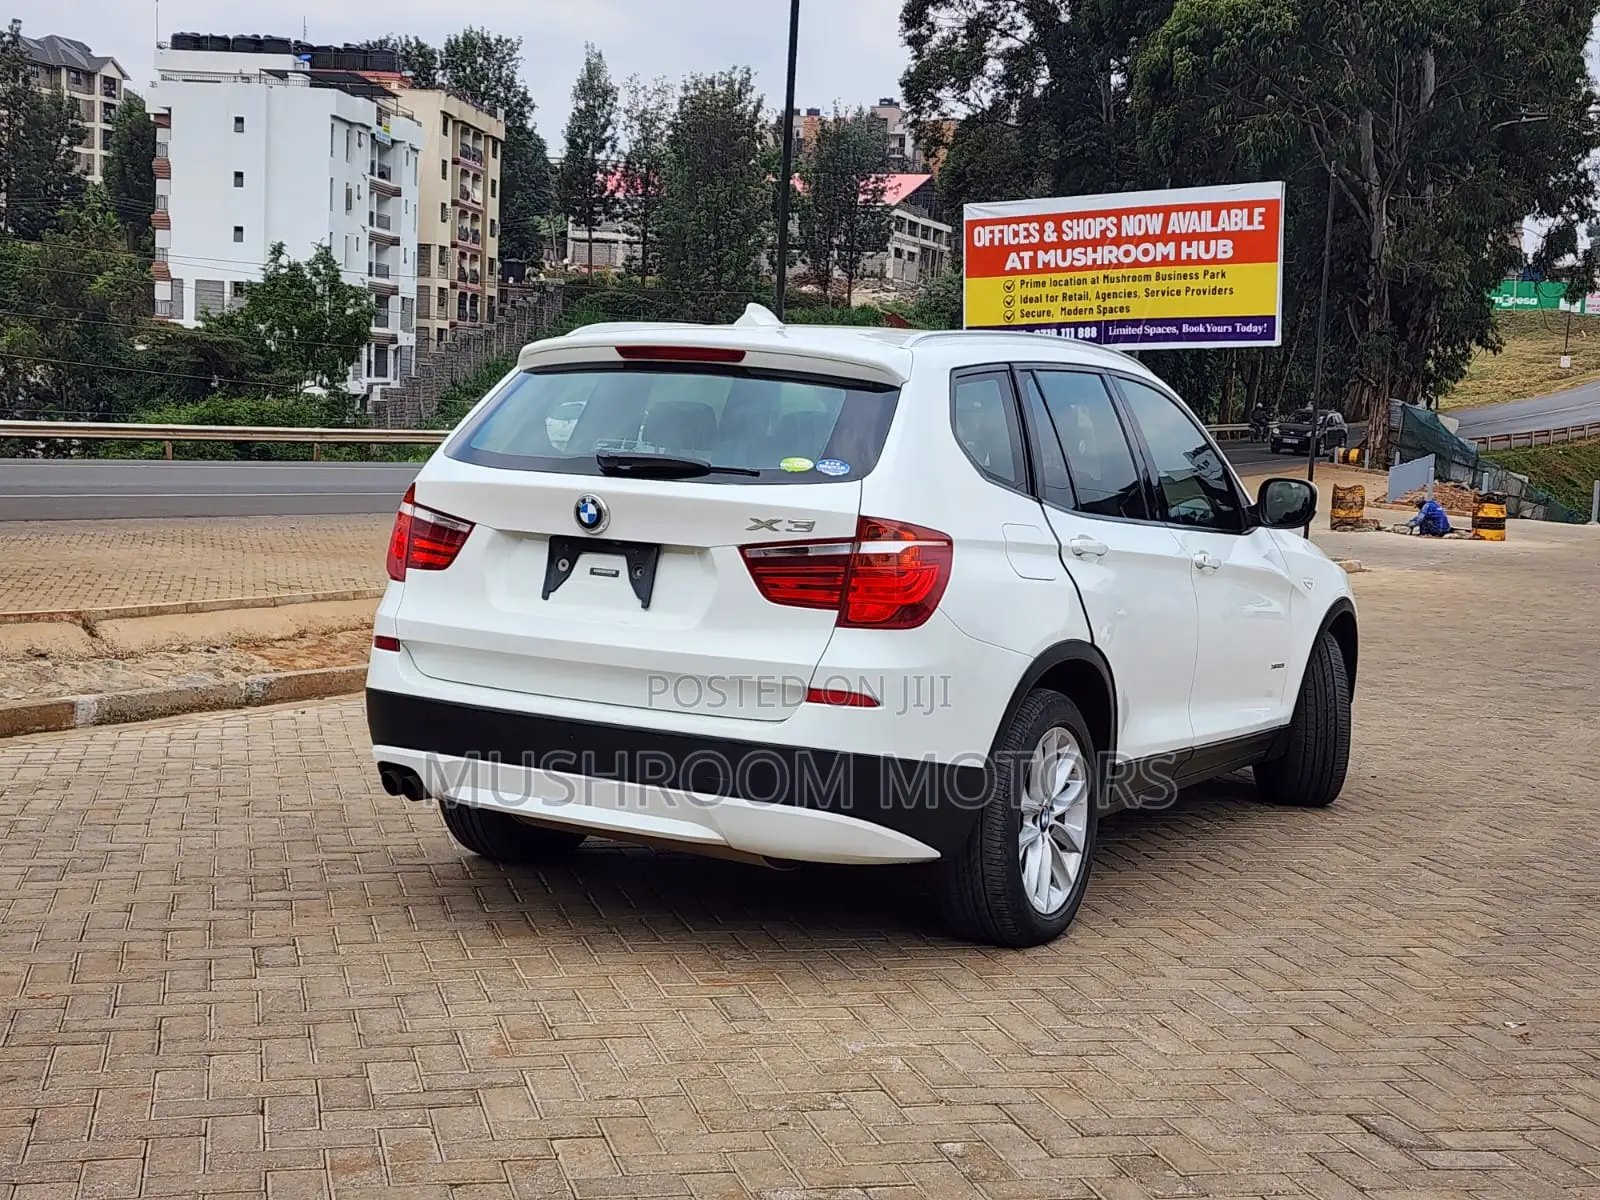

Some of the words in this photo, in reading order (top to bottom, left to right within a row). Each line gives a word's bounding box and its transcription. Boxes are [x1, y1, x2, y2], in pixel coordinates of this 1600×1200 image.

[974, 222, 1040, 247] OFFICES
[1043, 220, 1058, 243] &
[1062, 216, 1118, 241] SHOPS
[1121, 212, 1164, 237] NOW
[1167, 207, 1266, 234] AVAILABLE
[1004, 251, 1034, 271] AT
[1037, 241, 1176, 269] MUSHROOM
[1181, 239, 1234, 260] HUB
[1020, 279, 1047, 289] Prime
[1049, 276, 1088, 287] location
[1090, 276, 1100, 285] at
[1103, 273, 1152, 284] Mushroom
[1155, 270, 1200, 281] Business
[1203, 269, 1226, 280] Park
[1020, 294, 1042, 304] Ideal
[1045, 293, 1059, 303] for
[1062, 291, 1091, 302] Retail,
[1095, 289, 1141, 302] Agencies,
[1144, 286, 1182, 298] Service
[1184, 285, 1234, 296] Providers
[1020, 308, 1054, 319] Secure,
[1060, 306, 1094, 316] Modern
[1096, 304, 1131, 316] Spaces
[1077, 326, 1097, 339] 888
[1108, 325, 1143, 336] Limited
[1144, 324, 1179, 337] Spaces,
[1182, 323, 1206, 333] Book
[1206, 323, 1232, 333] Yours
[1234, 322, 1268, 335] Today!
[744, 517, 816, 533] X3
